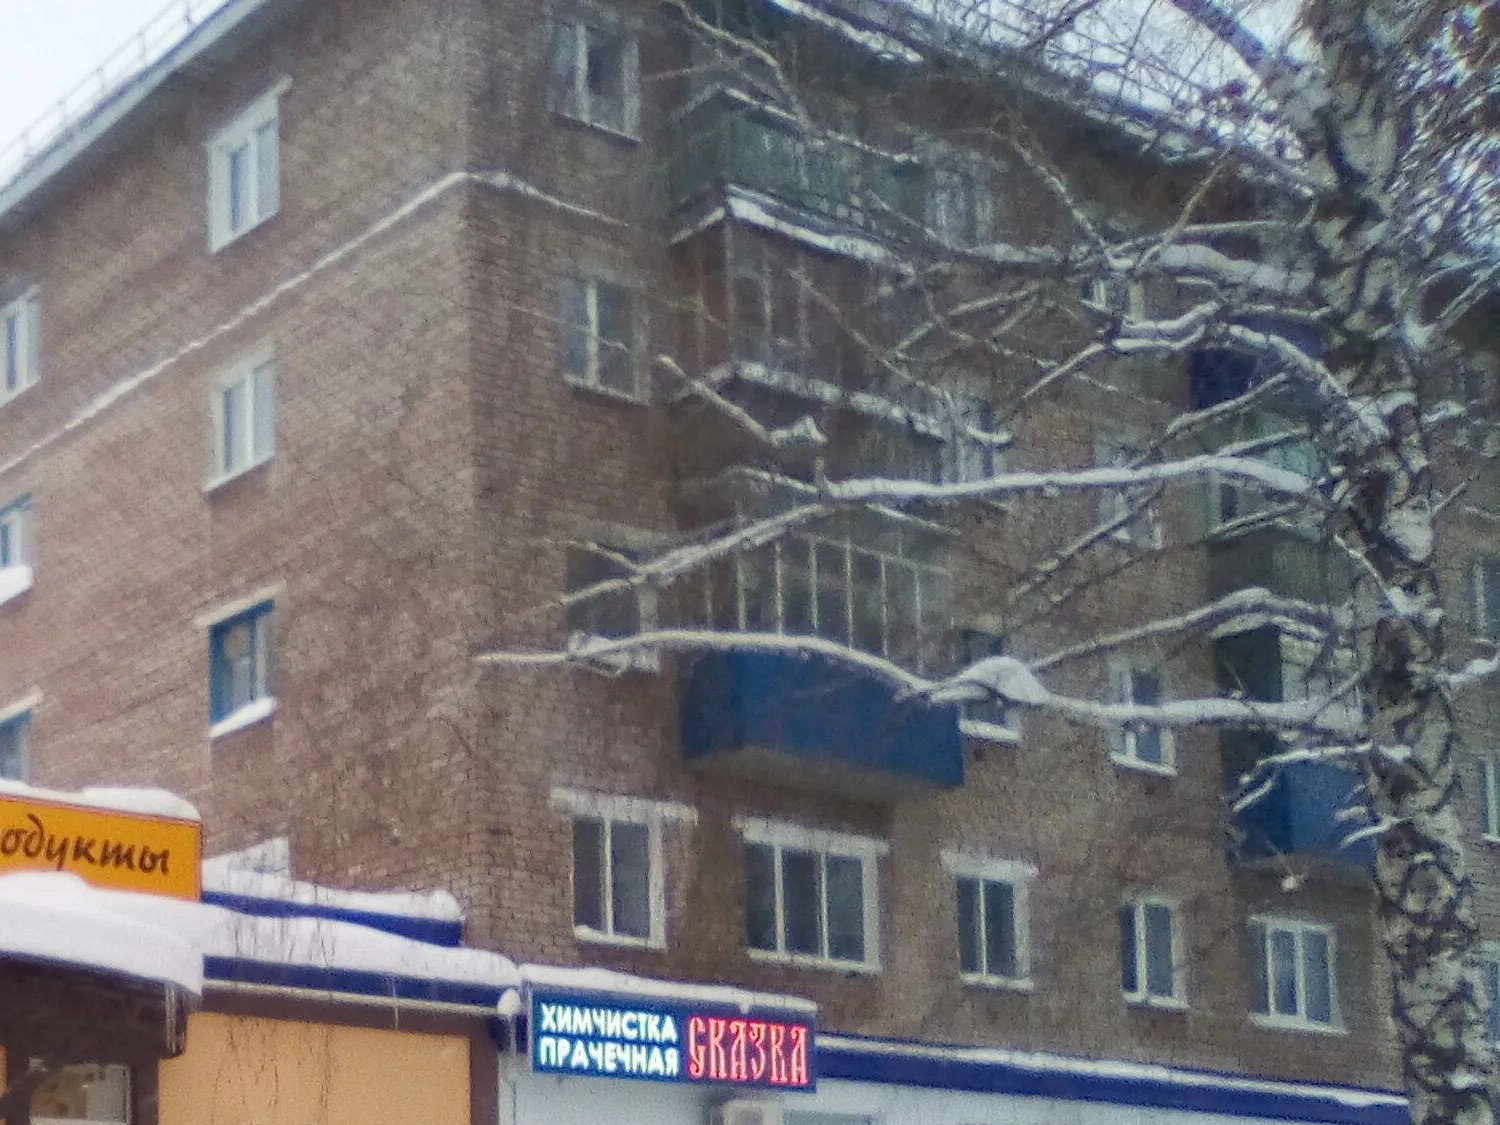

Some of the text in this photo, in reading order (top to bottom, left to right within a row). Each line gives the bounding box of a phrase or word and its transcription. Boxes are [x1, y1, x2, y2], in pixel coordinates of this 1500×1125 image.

[539, 1002, 678, 1043] ХИМЧИСТКА
[540, 1035, 679, 1077] ПРАЧЕЧНАЯ
[687, 1015, 808, 1085] СКАЗКА
